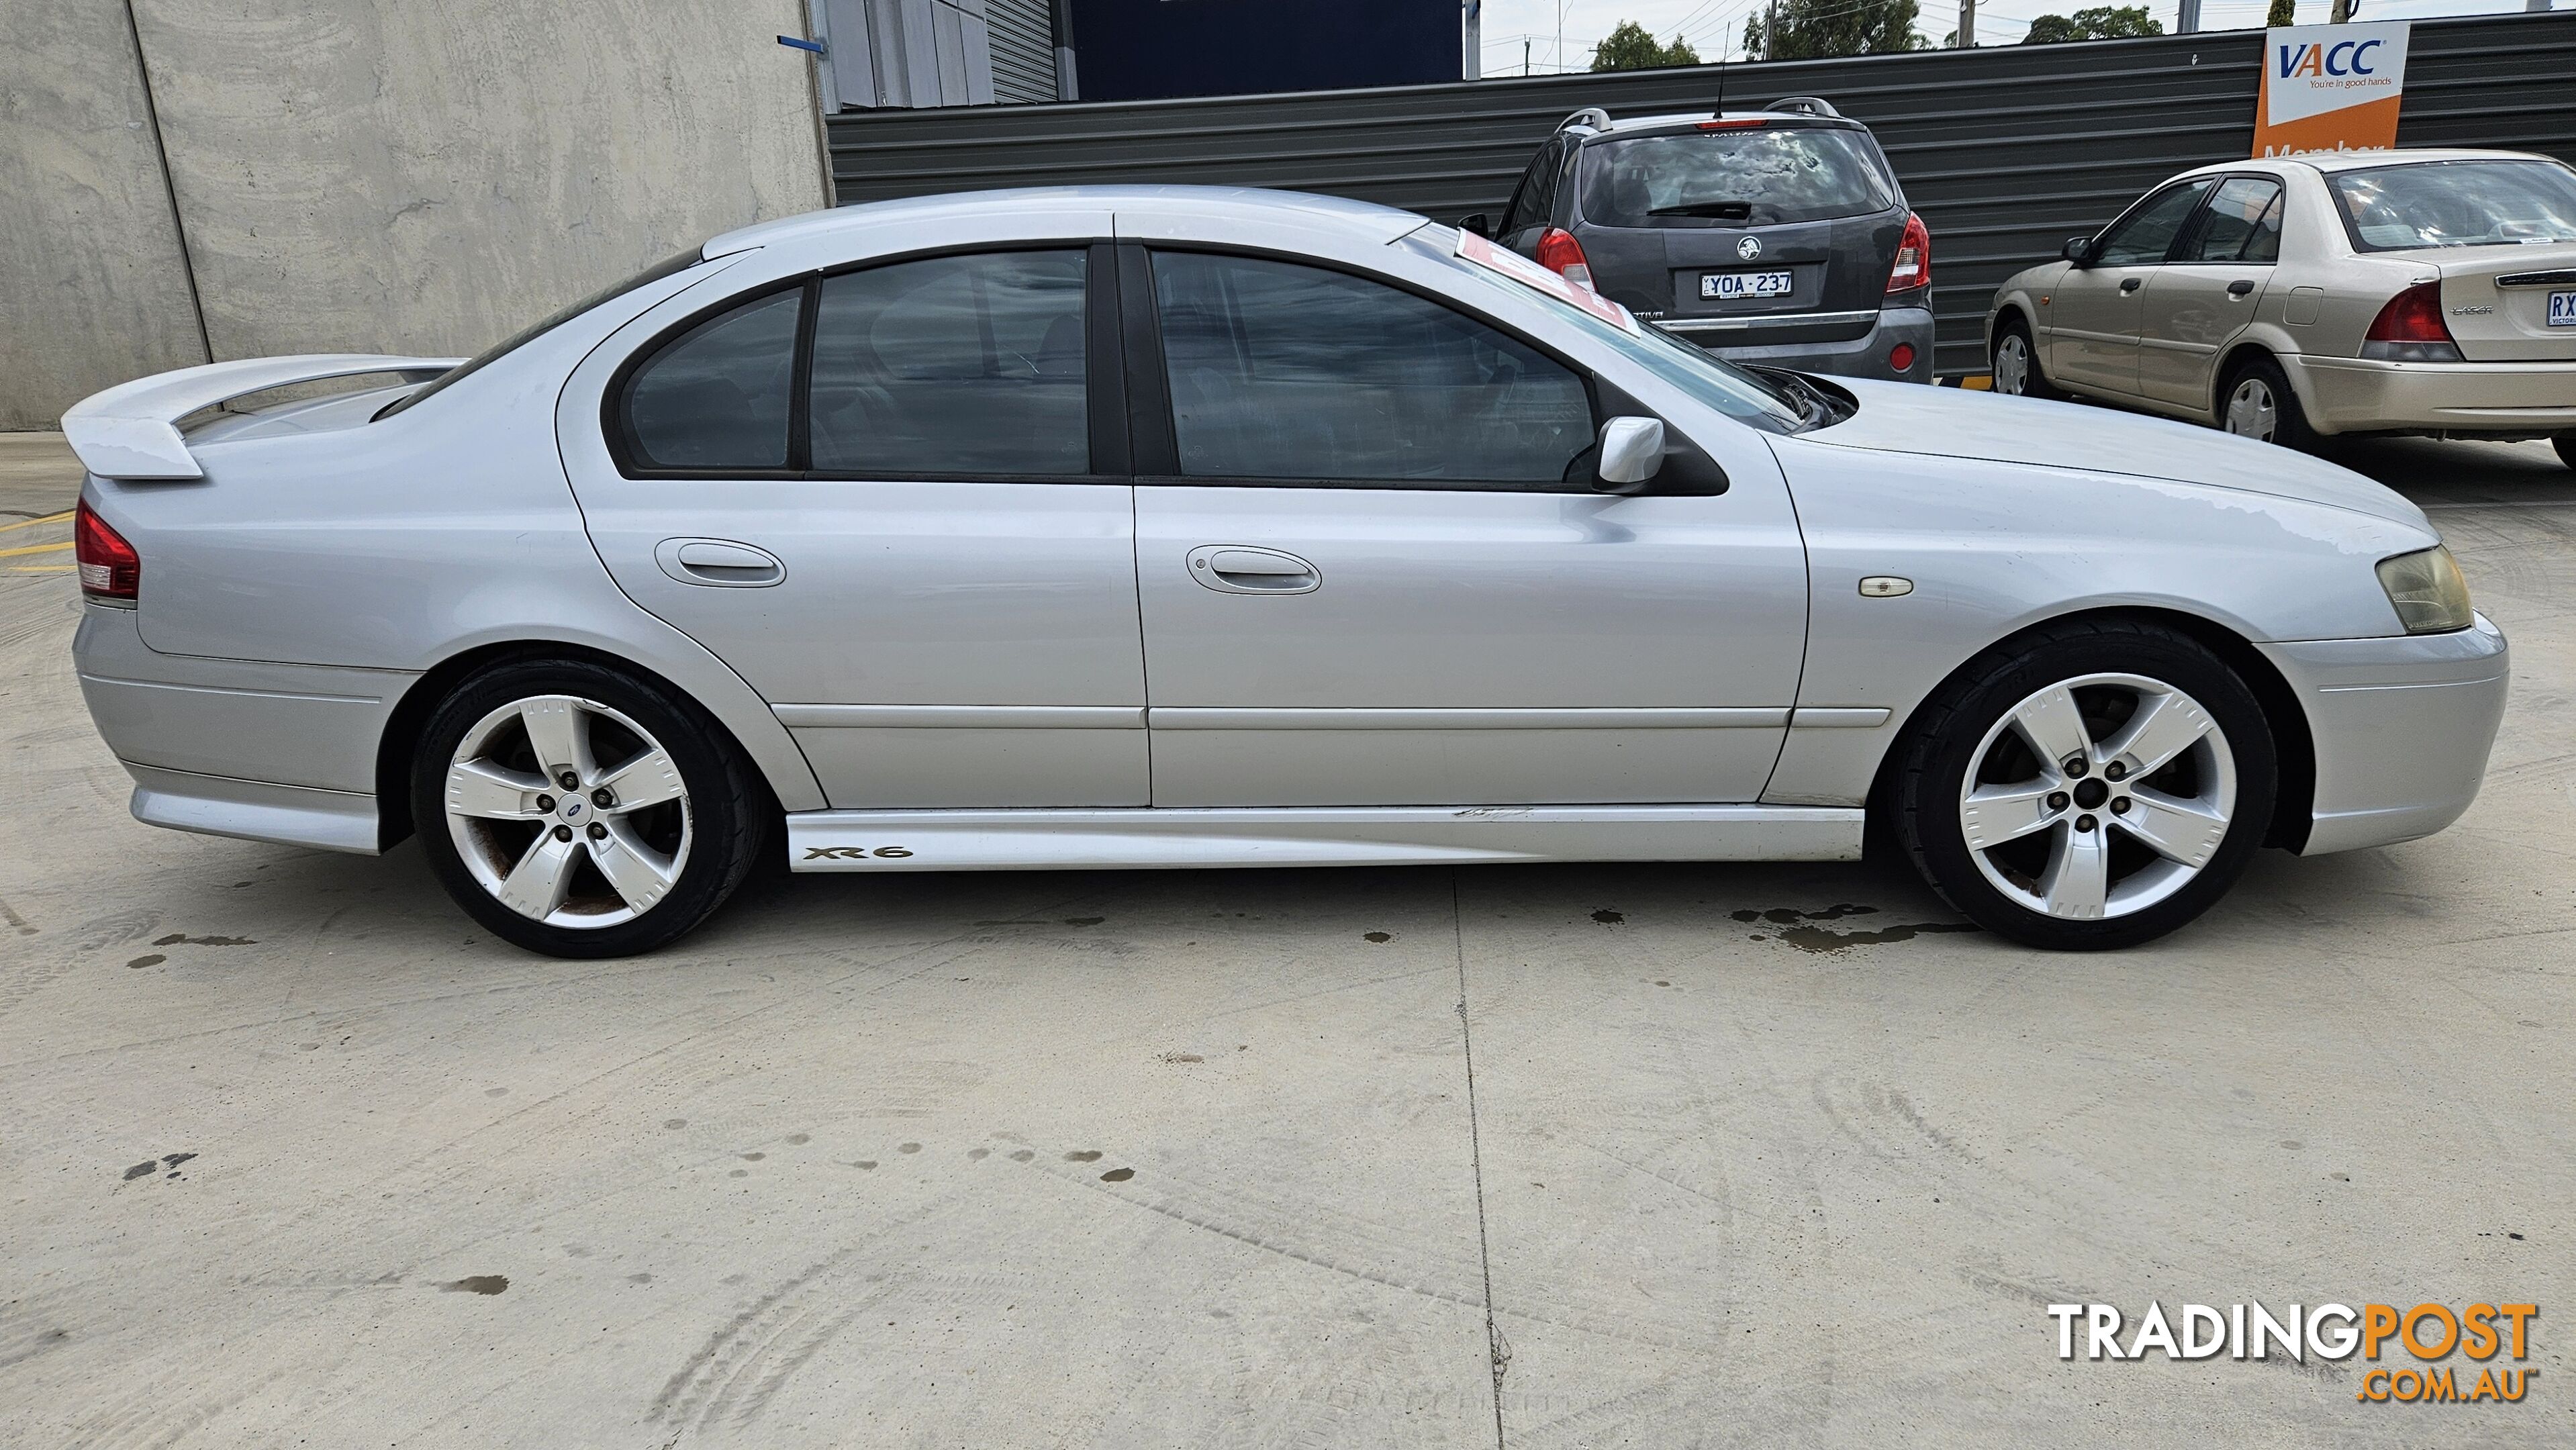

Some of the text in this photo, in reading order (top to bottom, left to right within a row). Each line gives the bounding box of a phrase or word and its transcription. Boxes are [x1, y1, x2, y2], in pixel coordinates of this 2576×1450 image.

[2280, 40, 2381, 79] VACC
[2310, 77, 2391, 89] You're in good hands
[1711, 274, 1791, 294] YOA 237
